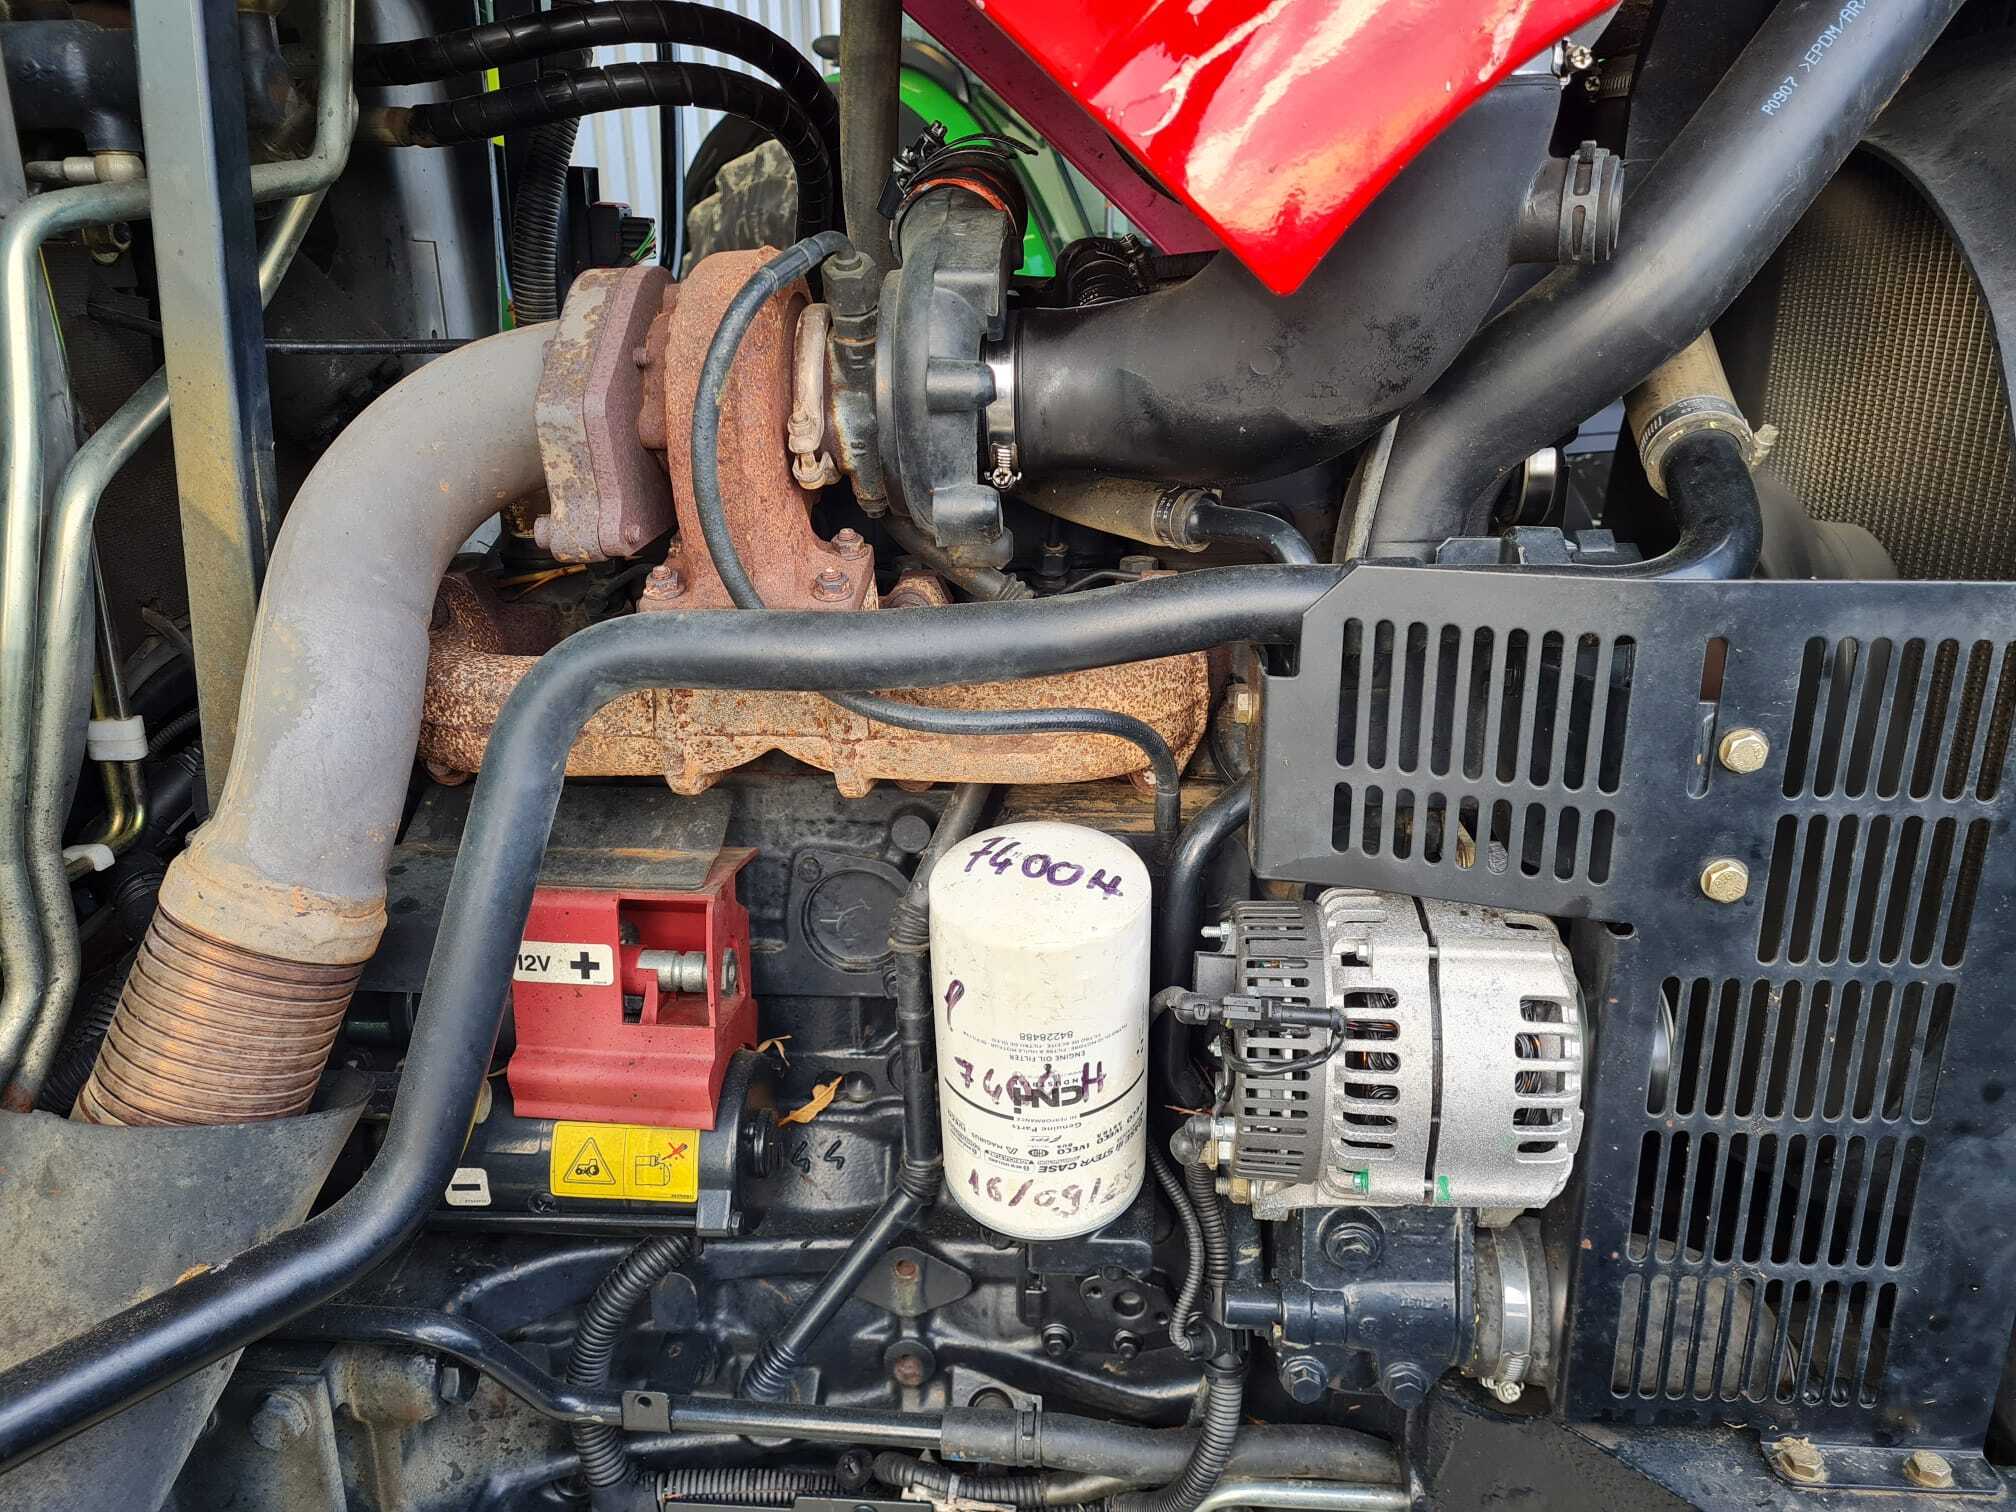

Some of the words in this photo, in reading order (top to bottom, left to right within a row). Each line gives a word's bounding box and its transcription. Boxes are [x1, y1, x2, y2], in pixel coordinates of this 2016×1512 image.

[517, 954, 551, 972] 12V
[1019, 1030, 1074, 1042] 84228488
[1009, 1055, 1036, 1063] FILTER
[1055, 1050, 1086, 1062] ENGINE
[1012, 1124, 1038, 1133] Parts
[1042, 1122, 1082, 1132] Genuine
[1057, 1143, 1090, 1155] IVECO
[1038, 1162, 1078, 1174] CASE
